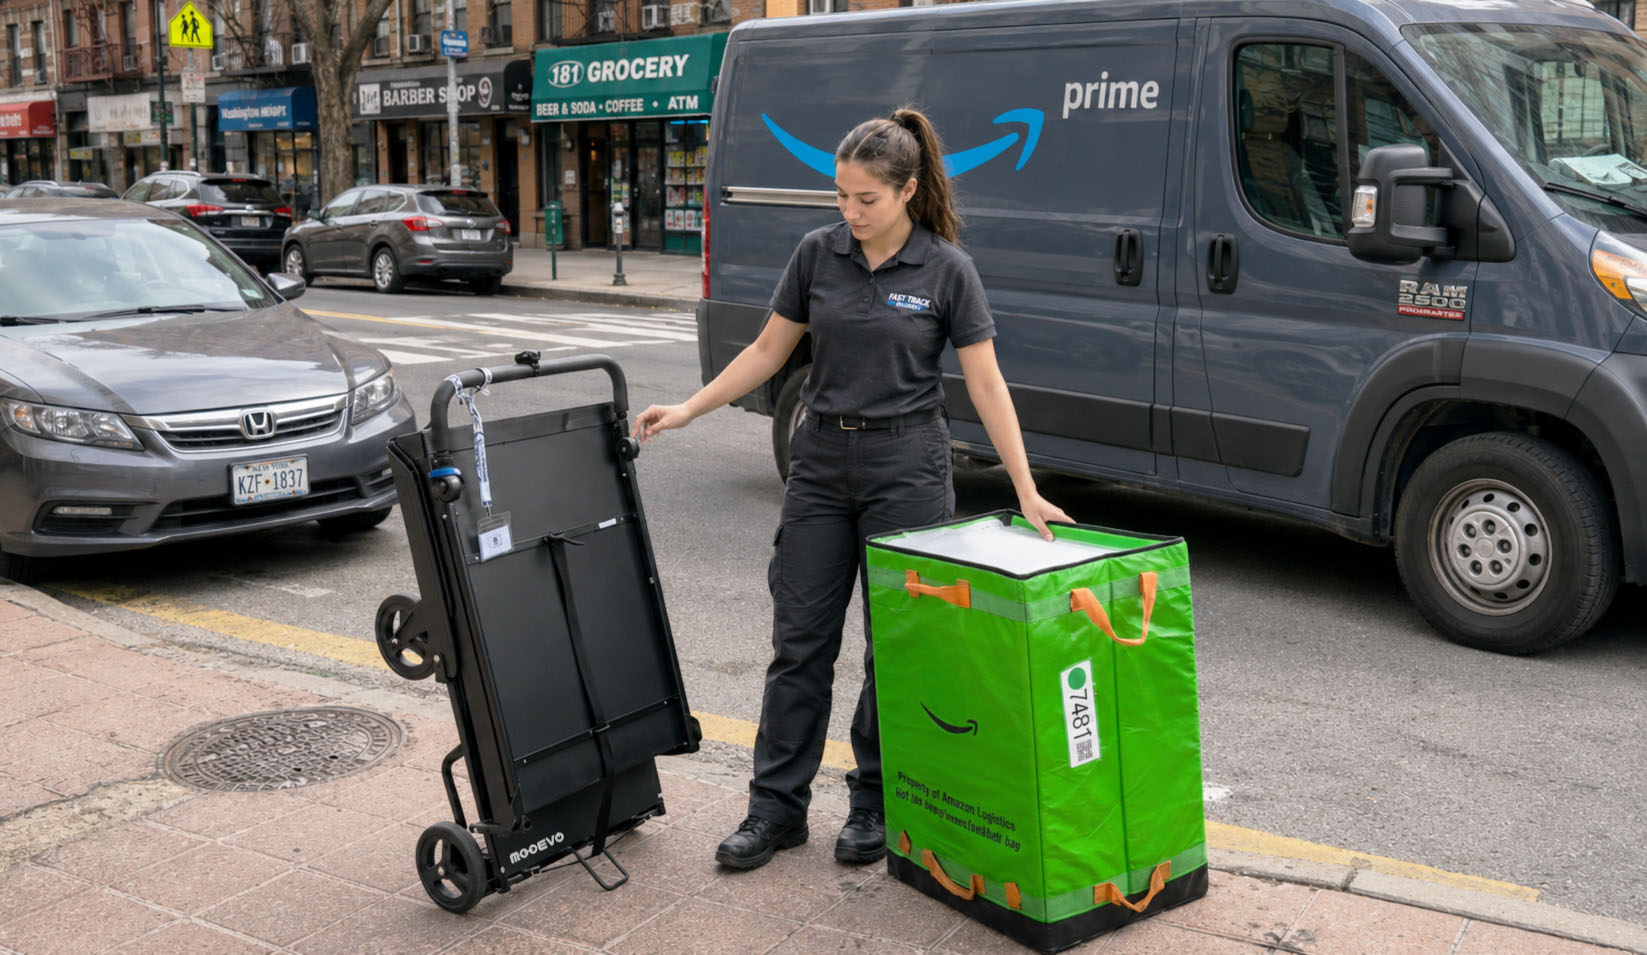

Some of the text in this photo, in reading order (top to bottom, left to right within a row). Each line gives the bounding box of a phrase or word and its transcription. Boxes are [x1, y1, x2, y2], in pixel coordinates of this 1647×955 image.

[552, 54, 690, 85] 181 GROCERY
[383, 88, 435, 107] BARBER
[438, 85, 476, 104] SOP
[536, 103, 559, 116] BEER
[561, 103, 568, 115] &
[570, 101, 596, 114] SODA
[605, 98, 644, 113] COFFEE
[667, 95, 699, 110] ATM
[1062, 71, 1159, 119] prime
[1399, 280, 1468, 298] RAM
[1399, 293, 1466, 309] 2500
[907, 296, 931, 308] TRACK
[238, 468, 303, 495] KZF 1837
[1069, 688, 1092, 740] 7481
[942, 792, 975, 815] Amazon
[977, 806, 1016, 832] Logistics
